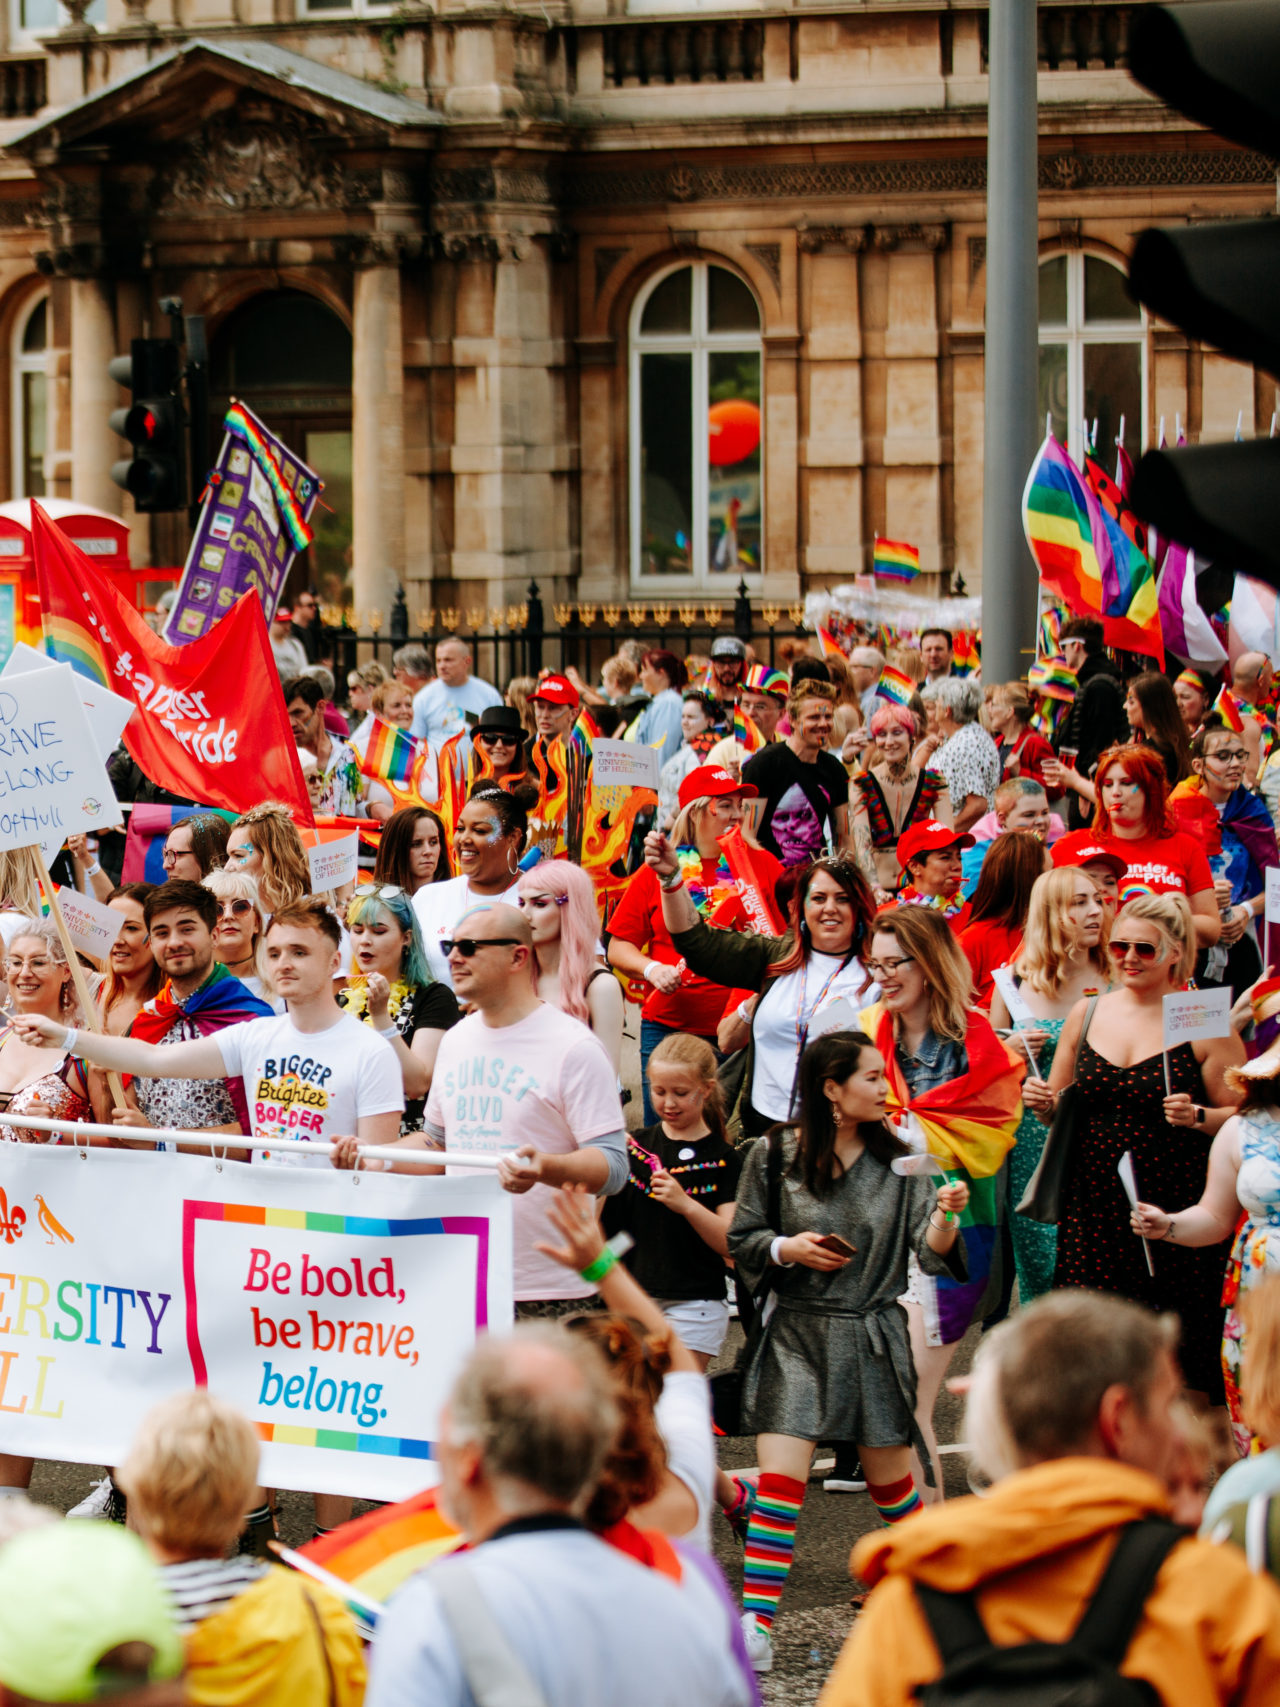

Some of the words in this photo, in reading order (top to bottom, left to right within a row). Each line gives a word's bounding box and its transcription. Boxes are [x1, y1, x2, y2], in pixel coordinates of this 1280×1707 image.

[1143, 871, 1182, 888] Pride
[61, 911, 110, 938] NIVERSITY
[264, 1054, 333, 1088] BIGGER
[444, 1055, 540, 1102] SUNSET
[257, 1080, 327, 1112] Brighter
[456, 1095, 503, 1123] BLVD
[255, 1102, 325, 1135] BOLDER
[243, 1247, 292, 1295] Be
[301, 1253, 406, 1305] bold,
[250, 1306, 302, 1349] be
[307, 1310, 420, 1367] brave,
[258, 1361, 387, 1428] belong.
